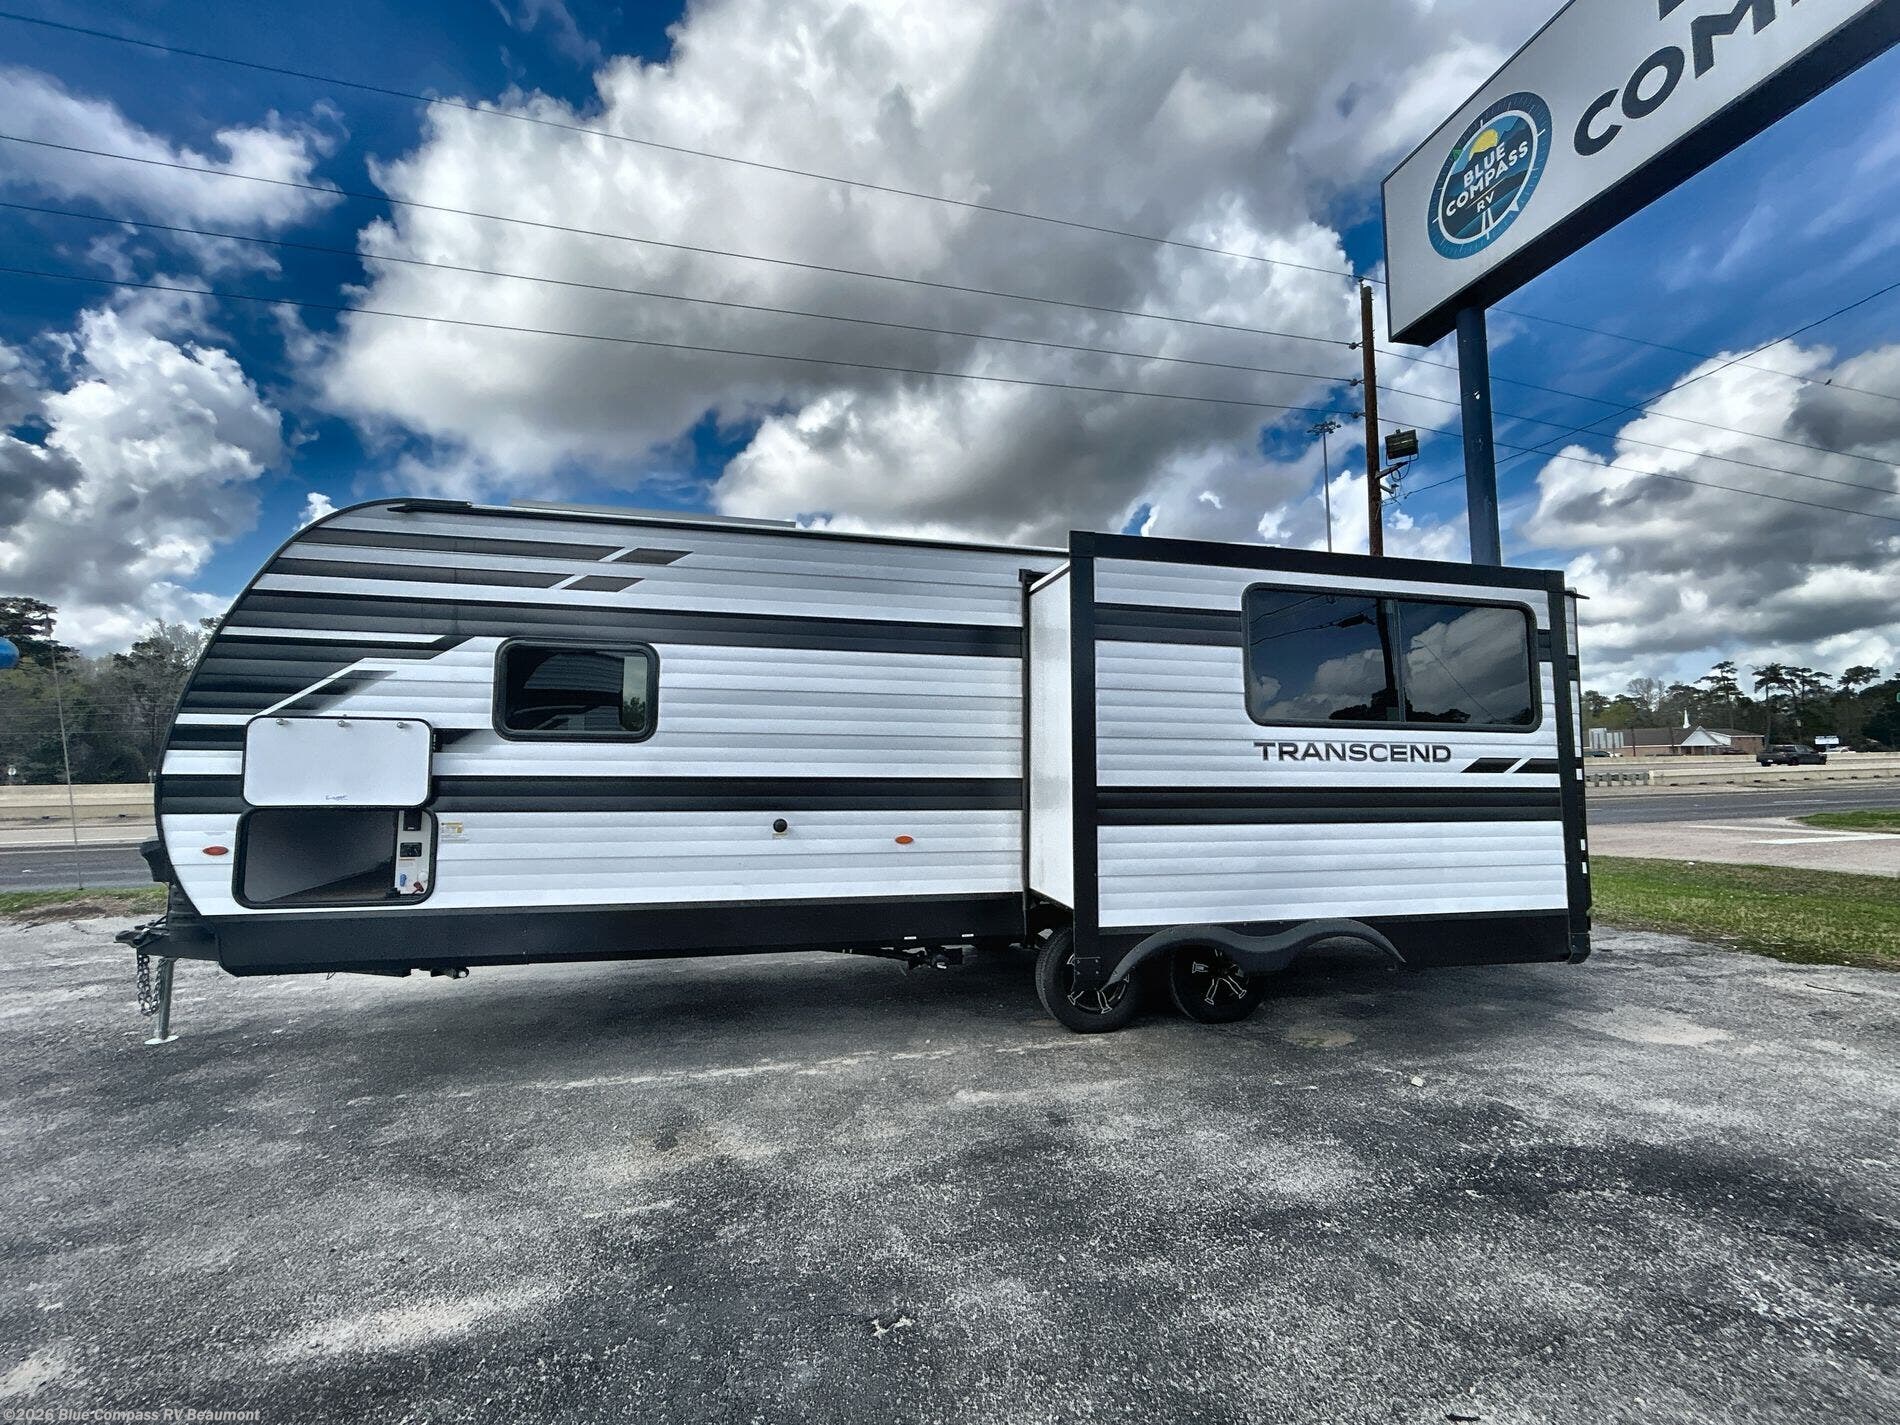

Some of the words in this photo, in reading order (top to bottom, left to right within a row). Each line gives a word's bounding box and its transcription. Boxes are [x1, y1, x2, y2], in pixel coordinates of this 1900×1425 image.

[1573, 0, 1800, 157] COM
[1446, 141, 1528, 217] COMPASS
[1463, 141, 1506, 188] BLUE
[1476, 190, 1495, 213] RV
[1254, 742, 1451, 763] TRANSCEND
